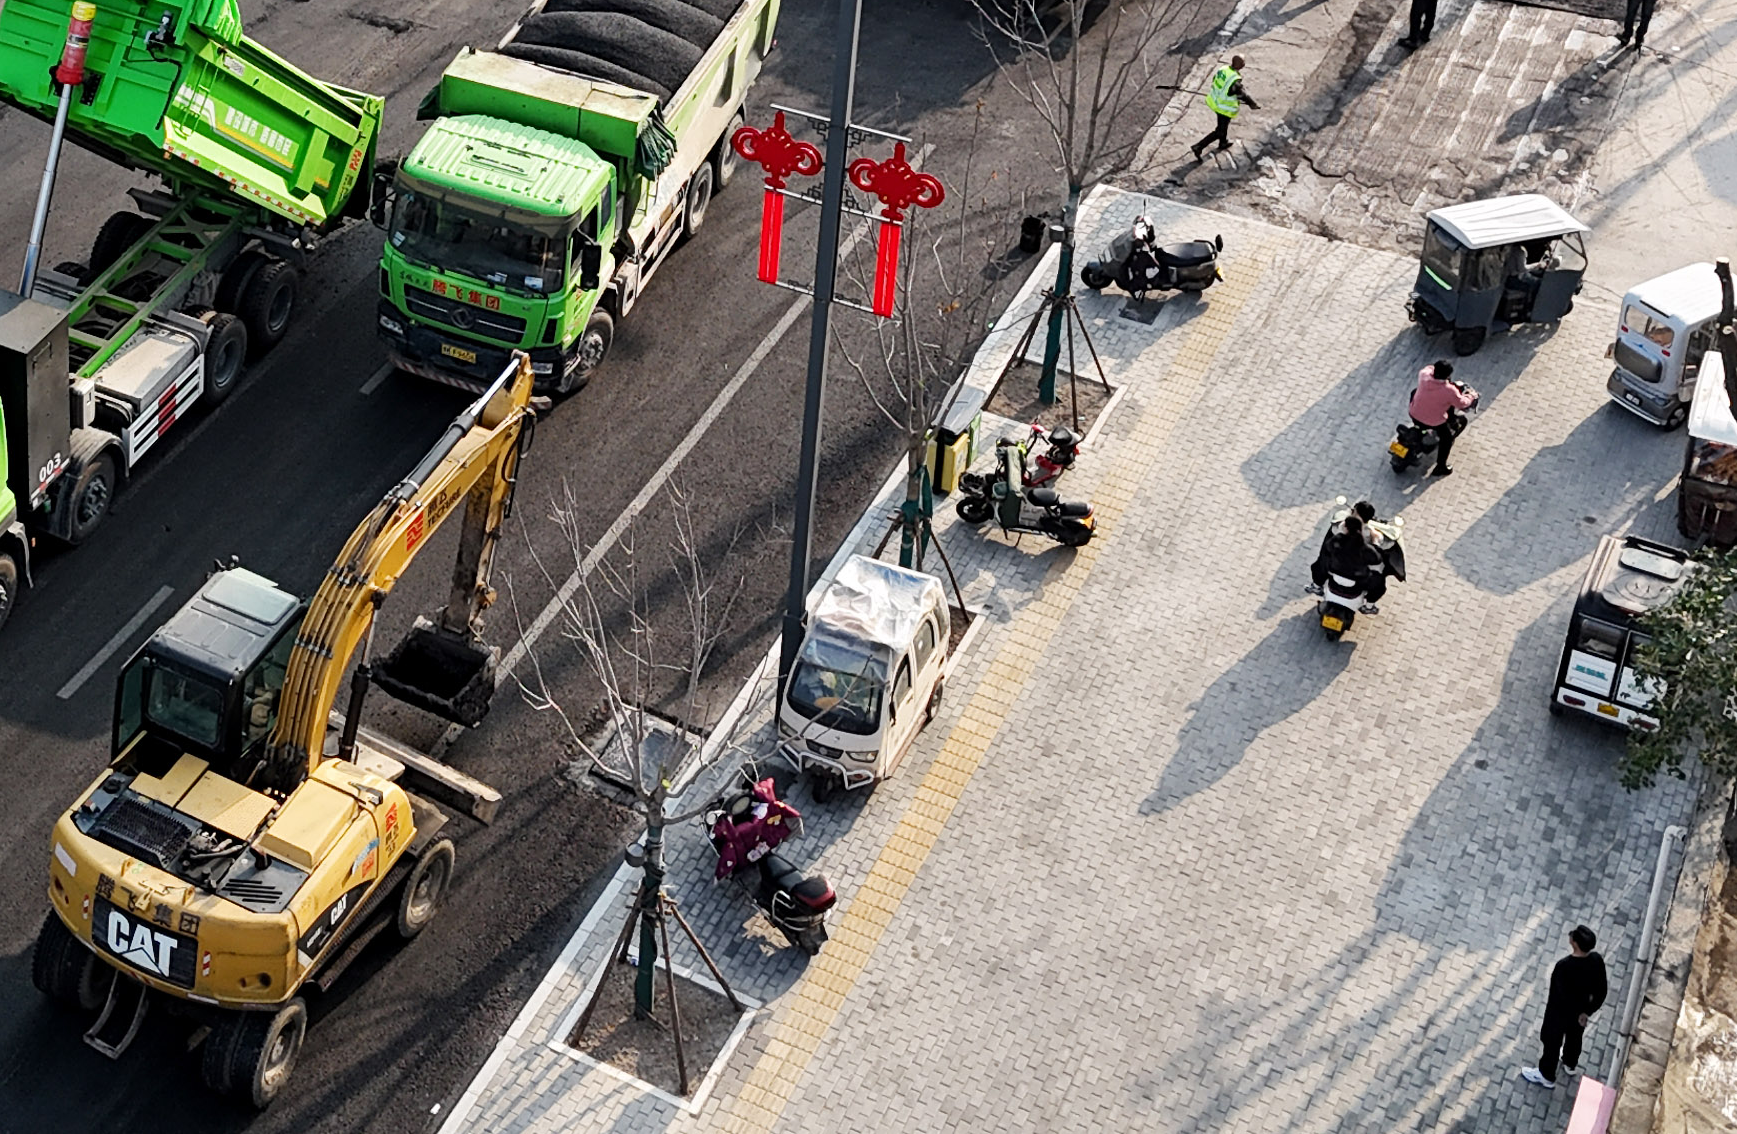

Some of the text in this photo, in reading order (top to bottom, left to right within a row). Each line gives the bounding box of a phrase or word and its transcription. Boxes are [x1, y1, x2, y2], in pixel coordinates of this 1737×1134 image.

[432, 278, 500, 311] 腾飞集团
[38, 453, 62, 482] 003
[95, 872, 201, 937] 腾飞集团
[330, 892, 348, 925] CAT
[107, 907, 178, 978] CAT
